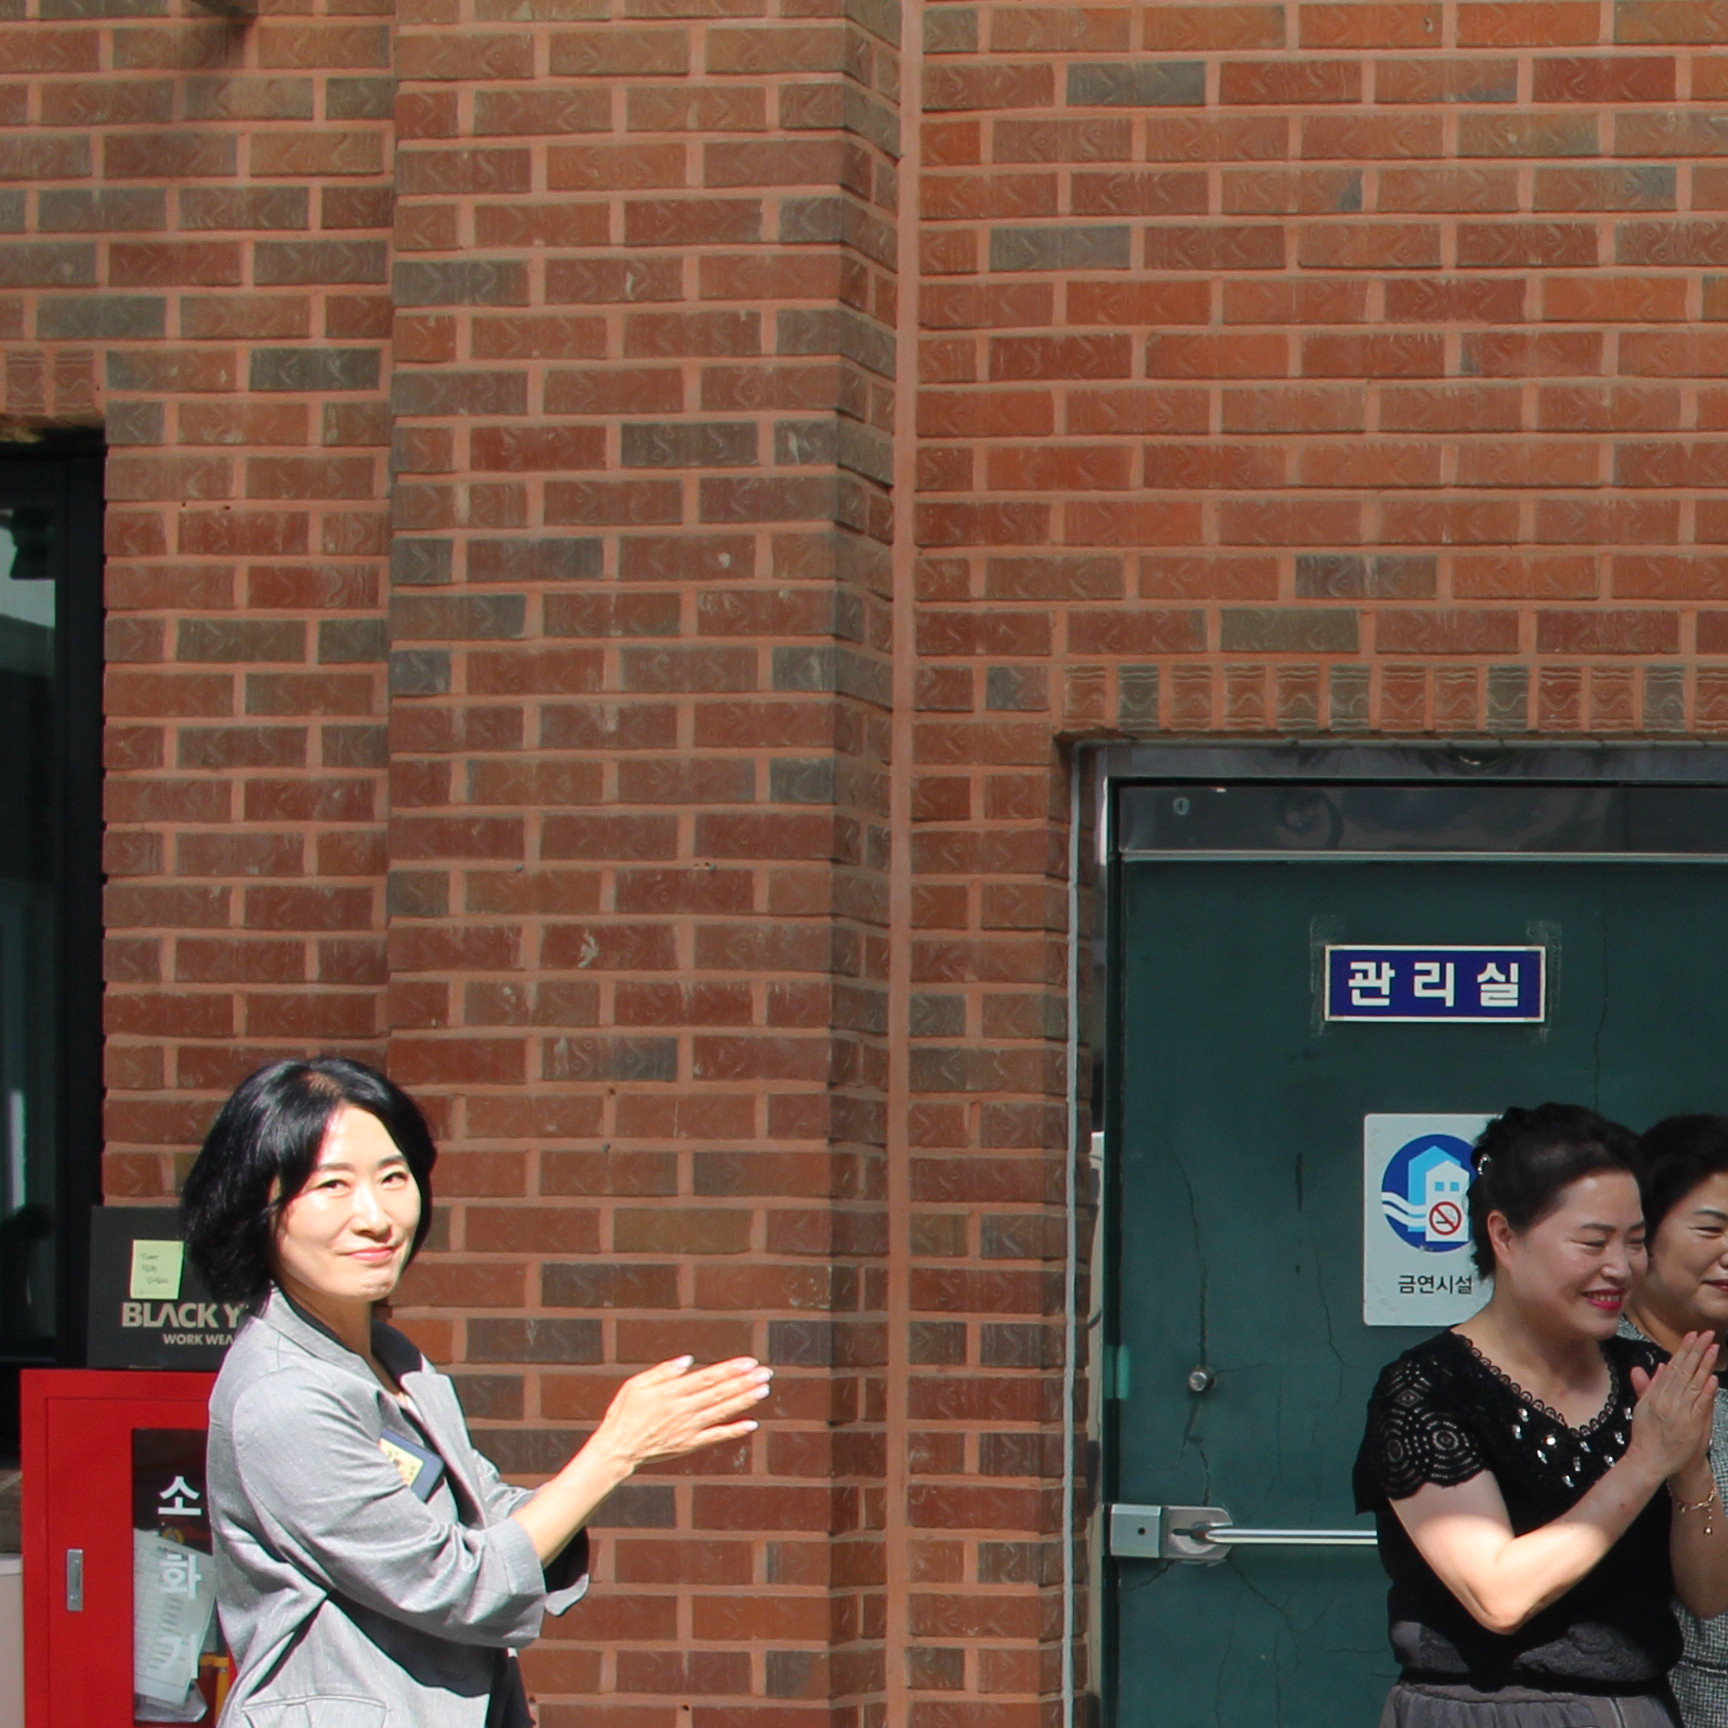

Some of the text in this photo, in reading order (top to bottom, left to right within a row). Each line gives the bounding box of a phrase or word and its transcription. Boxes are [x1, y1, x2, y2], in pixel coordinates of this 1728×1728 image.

[1347, 961, 1520, 1008] 관리실
[1396, 1273, 1474, 1295] 금연시설
[121, 1301, 220, 1329] BLACK
[162, 1333, 203, 1346] WORK
